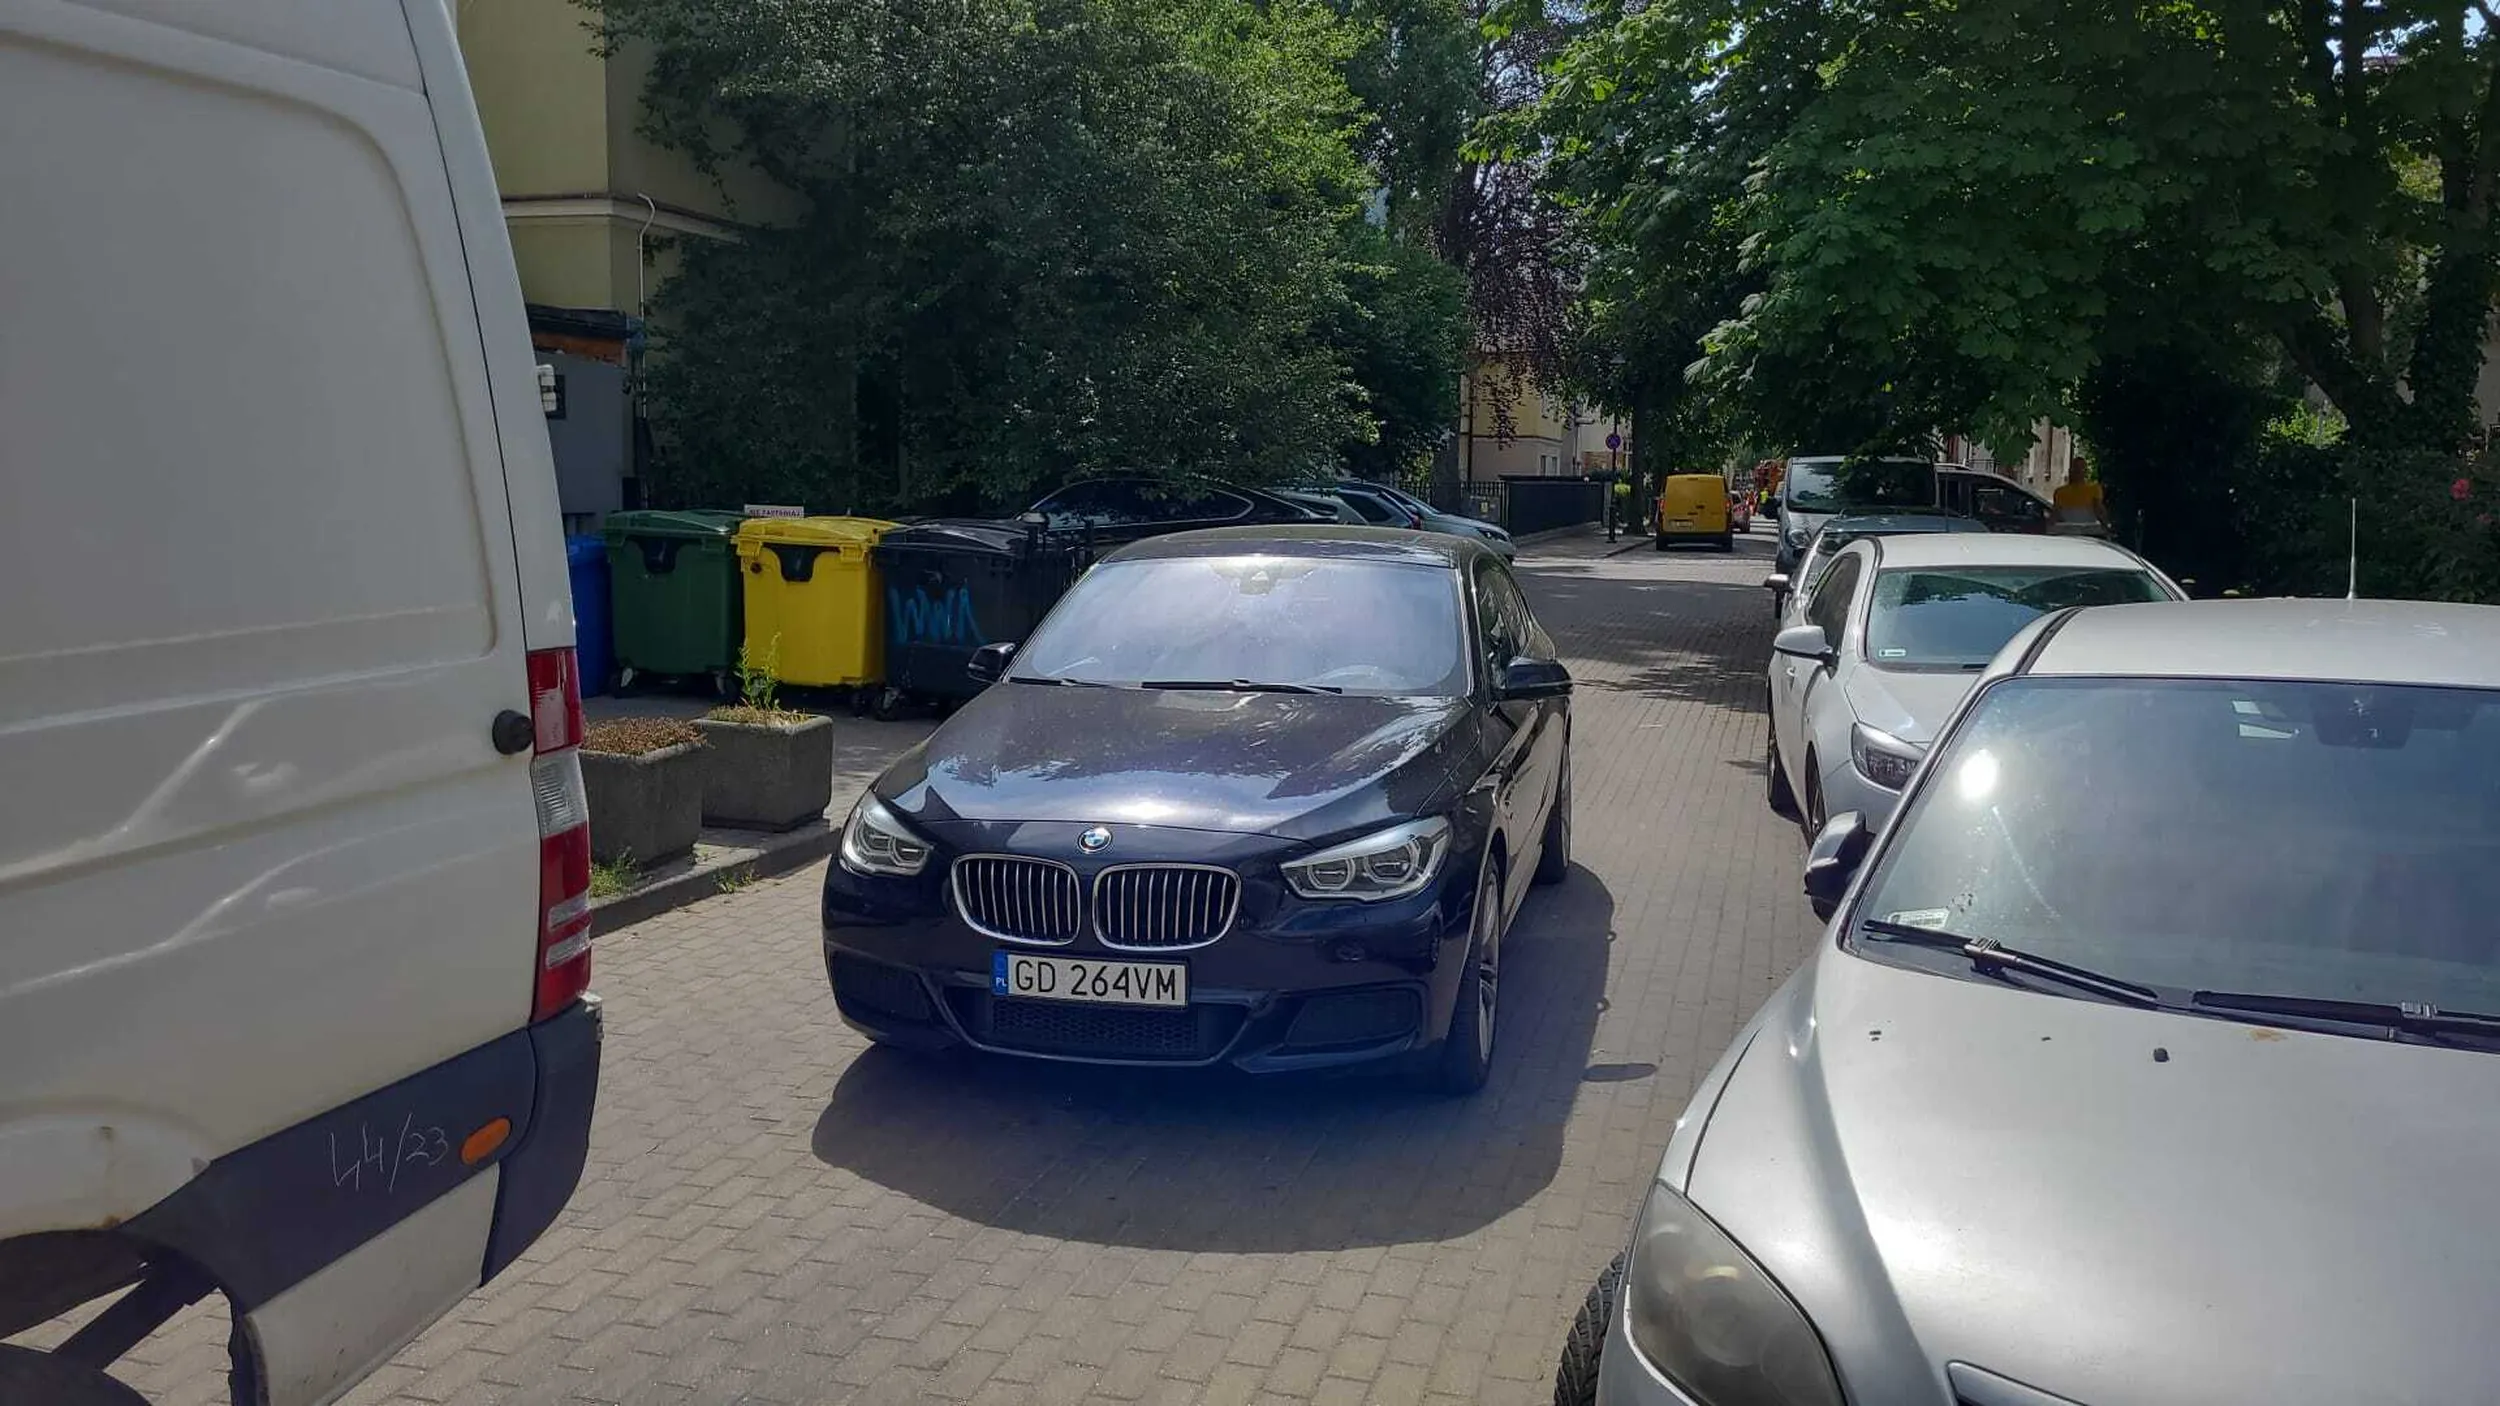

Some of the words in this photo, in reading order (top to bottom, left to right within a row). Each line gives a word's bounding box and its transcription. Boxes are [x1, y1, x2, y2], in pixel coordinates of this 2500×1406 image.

[996, 977, 1007, 987] PL
[1015, 959, 1056, 993] GD
[1071, 964, 1176, 1001] 264VM
[330, 1112, 449, 1193] 44/23
